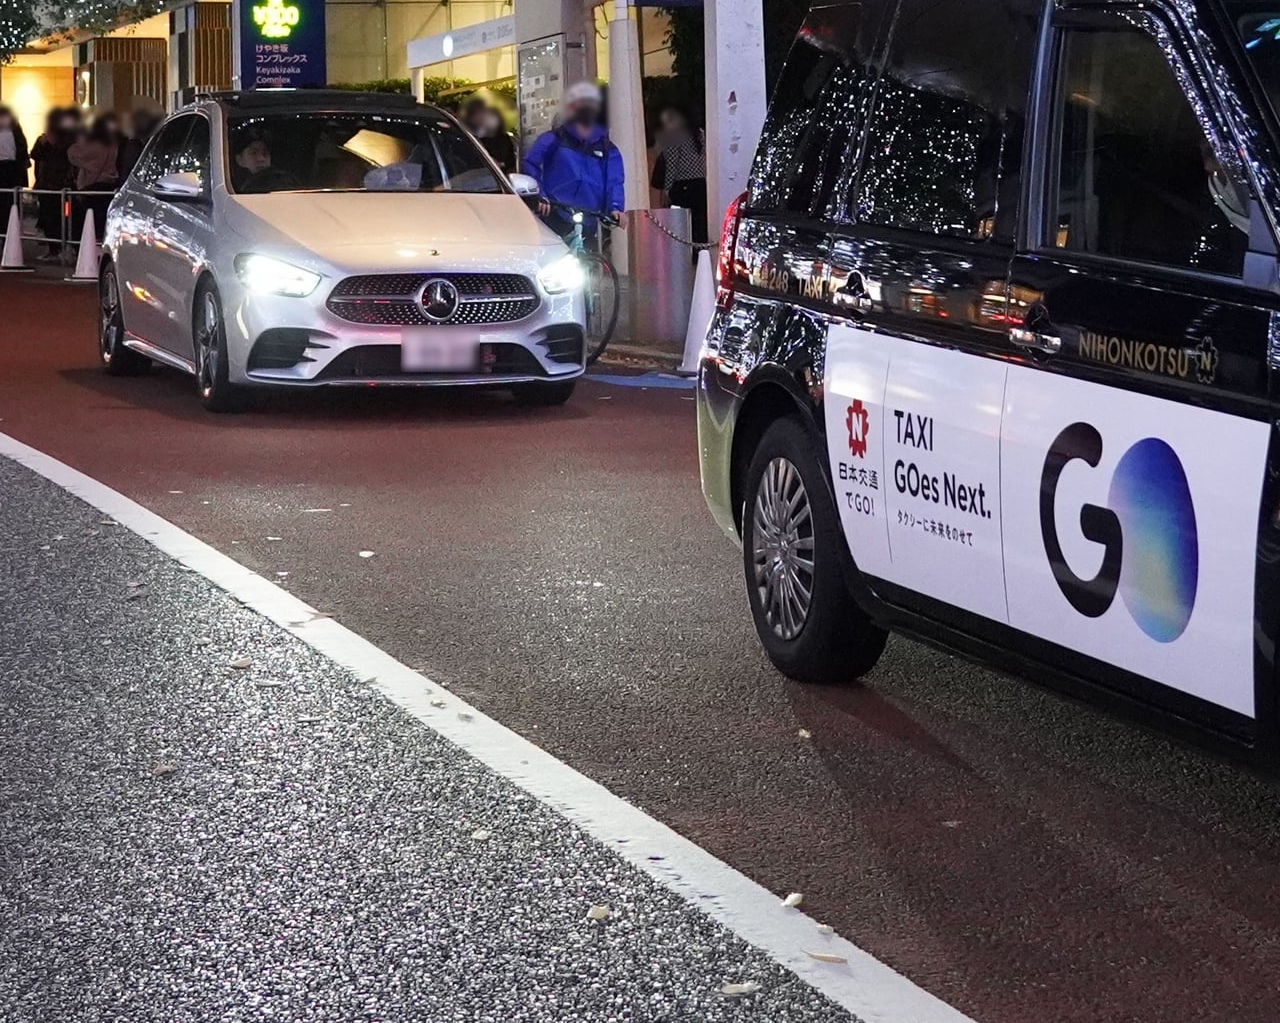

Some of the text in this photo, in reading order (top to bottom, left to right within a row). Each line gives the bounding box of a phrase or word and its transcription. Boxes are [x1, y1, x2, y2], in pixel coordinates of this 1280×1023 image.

[255, 44, 289, 53] けやき坂
[255, 66, 301, 75] Keyakizaka
[1078, 331, 1190, 378] NIHONKOTSU
[893, 409, 934, 452] TAXI
[838, 461, 879, 490] 日本交通
[894, 459, 992, 519] GOes Next.
[845, 491, 875, 516] でGO!
[897, 509, 973, 546] タクシーに未来をのせて
[1038, 421, 1200, 643] GO
